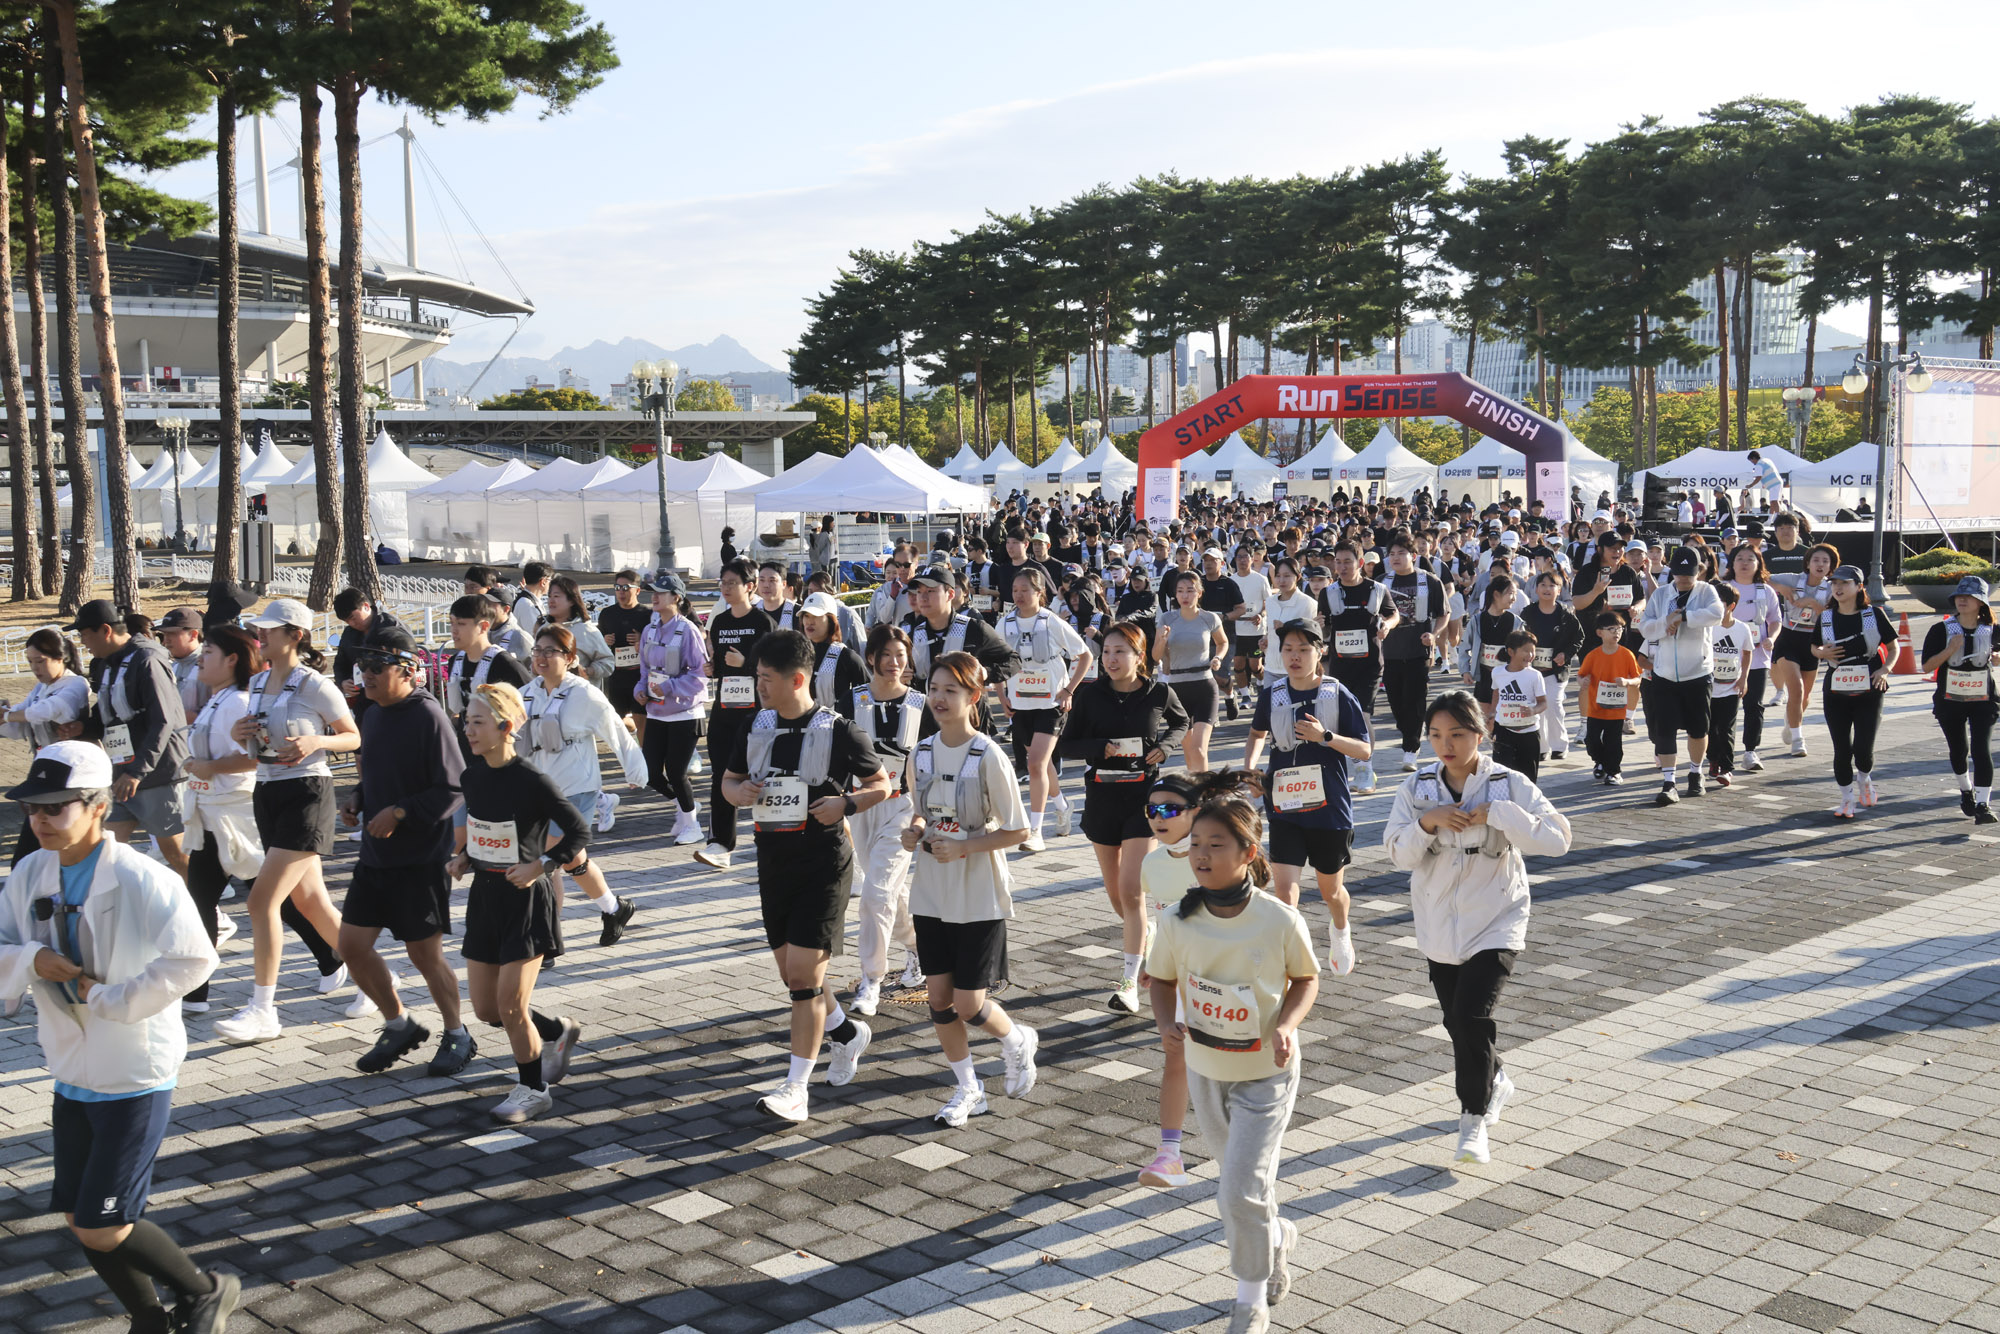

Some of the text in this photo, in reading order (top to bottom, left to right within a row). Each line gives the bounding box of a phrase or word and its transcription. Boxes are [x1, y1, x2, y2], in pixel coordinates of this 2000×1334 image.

[1175, 395, 1244, 446] START
[1465, 390, 1540, 440] FINISH
[1680, 477, 1738, 487] SS ROOM
[1830, 475, 1853, 486] MC
[739, 628, 755, 636] RICHES
[719, 636, 741, 644] DÉPRIMÉS
[110, 738, 126, 748] 5244
[1286, 781, 1317, 793] 6076
[766, 795, 800, 806] 5324
[478, 836, 511, 848] 6253
[1199, 981, 1223, 995] Sense
[1192, 998, 1249, 1022] W 6140
